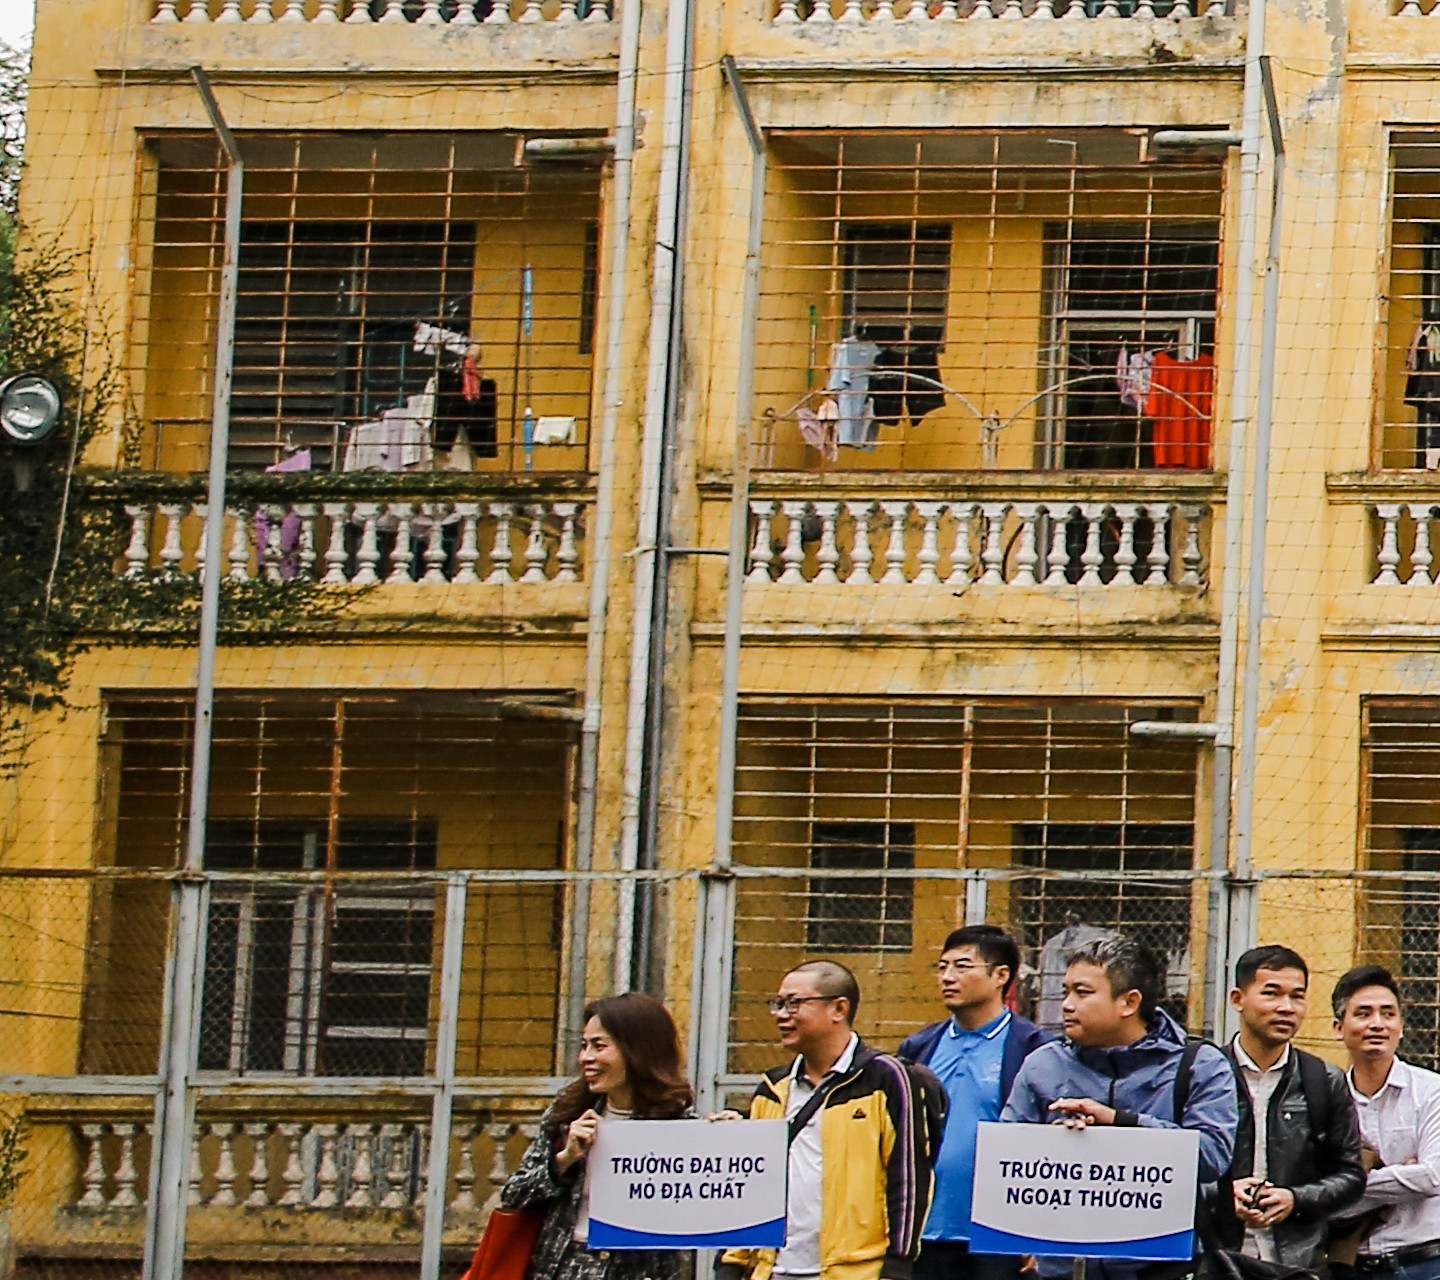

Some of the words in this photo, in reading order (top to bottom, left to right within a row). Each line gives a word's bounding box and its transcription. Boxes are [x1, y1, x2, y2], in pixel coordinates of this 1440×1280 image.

[612, 1152, 684, 1174] TRƯỜNG
[691, 1158, 723, 1177] ĐẠI
[729, 1157, 765, 1177] HỌC
[1000, 1157, 1082, 1180] TRƯỜNG
[1090, 1165, 1125, 1185] ĐẠI
[1133, 1167, 1173, 1187] HỌC
[630, 1178, 655, 1199] MỎ
[661, 1183, 693, 1203] ĐỊA
[700, 1178, 745, 1199] CHẤT
[1007, 1188, 1071, 1210] NGOẠI
[1078, 1189, 1163, 1209] THƯƠNG
